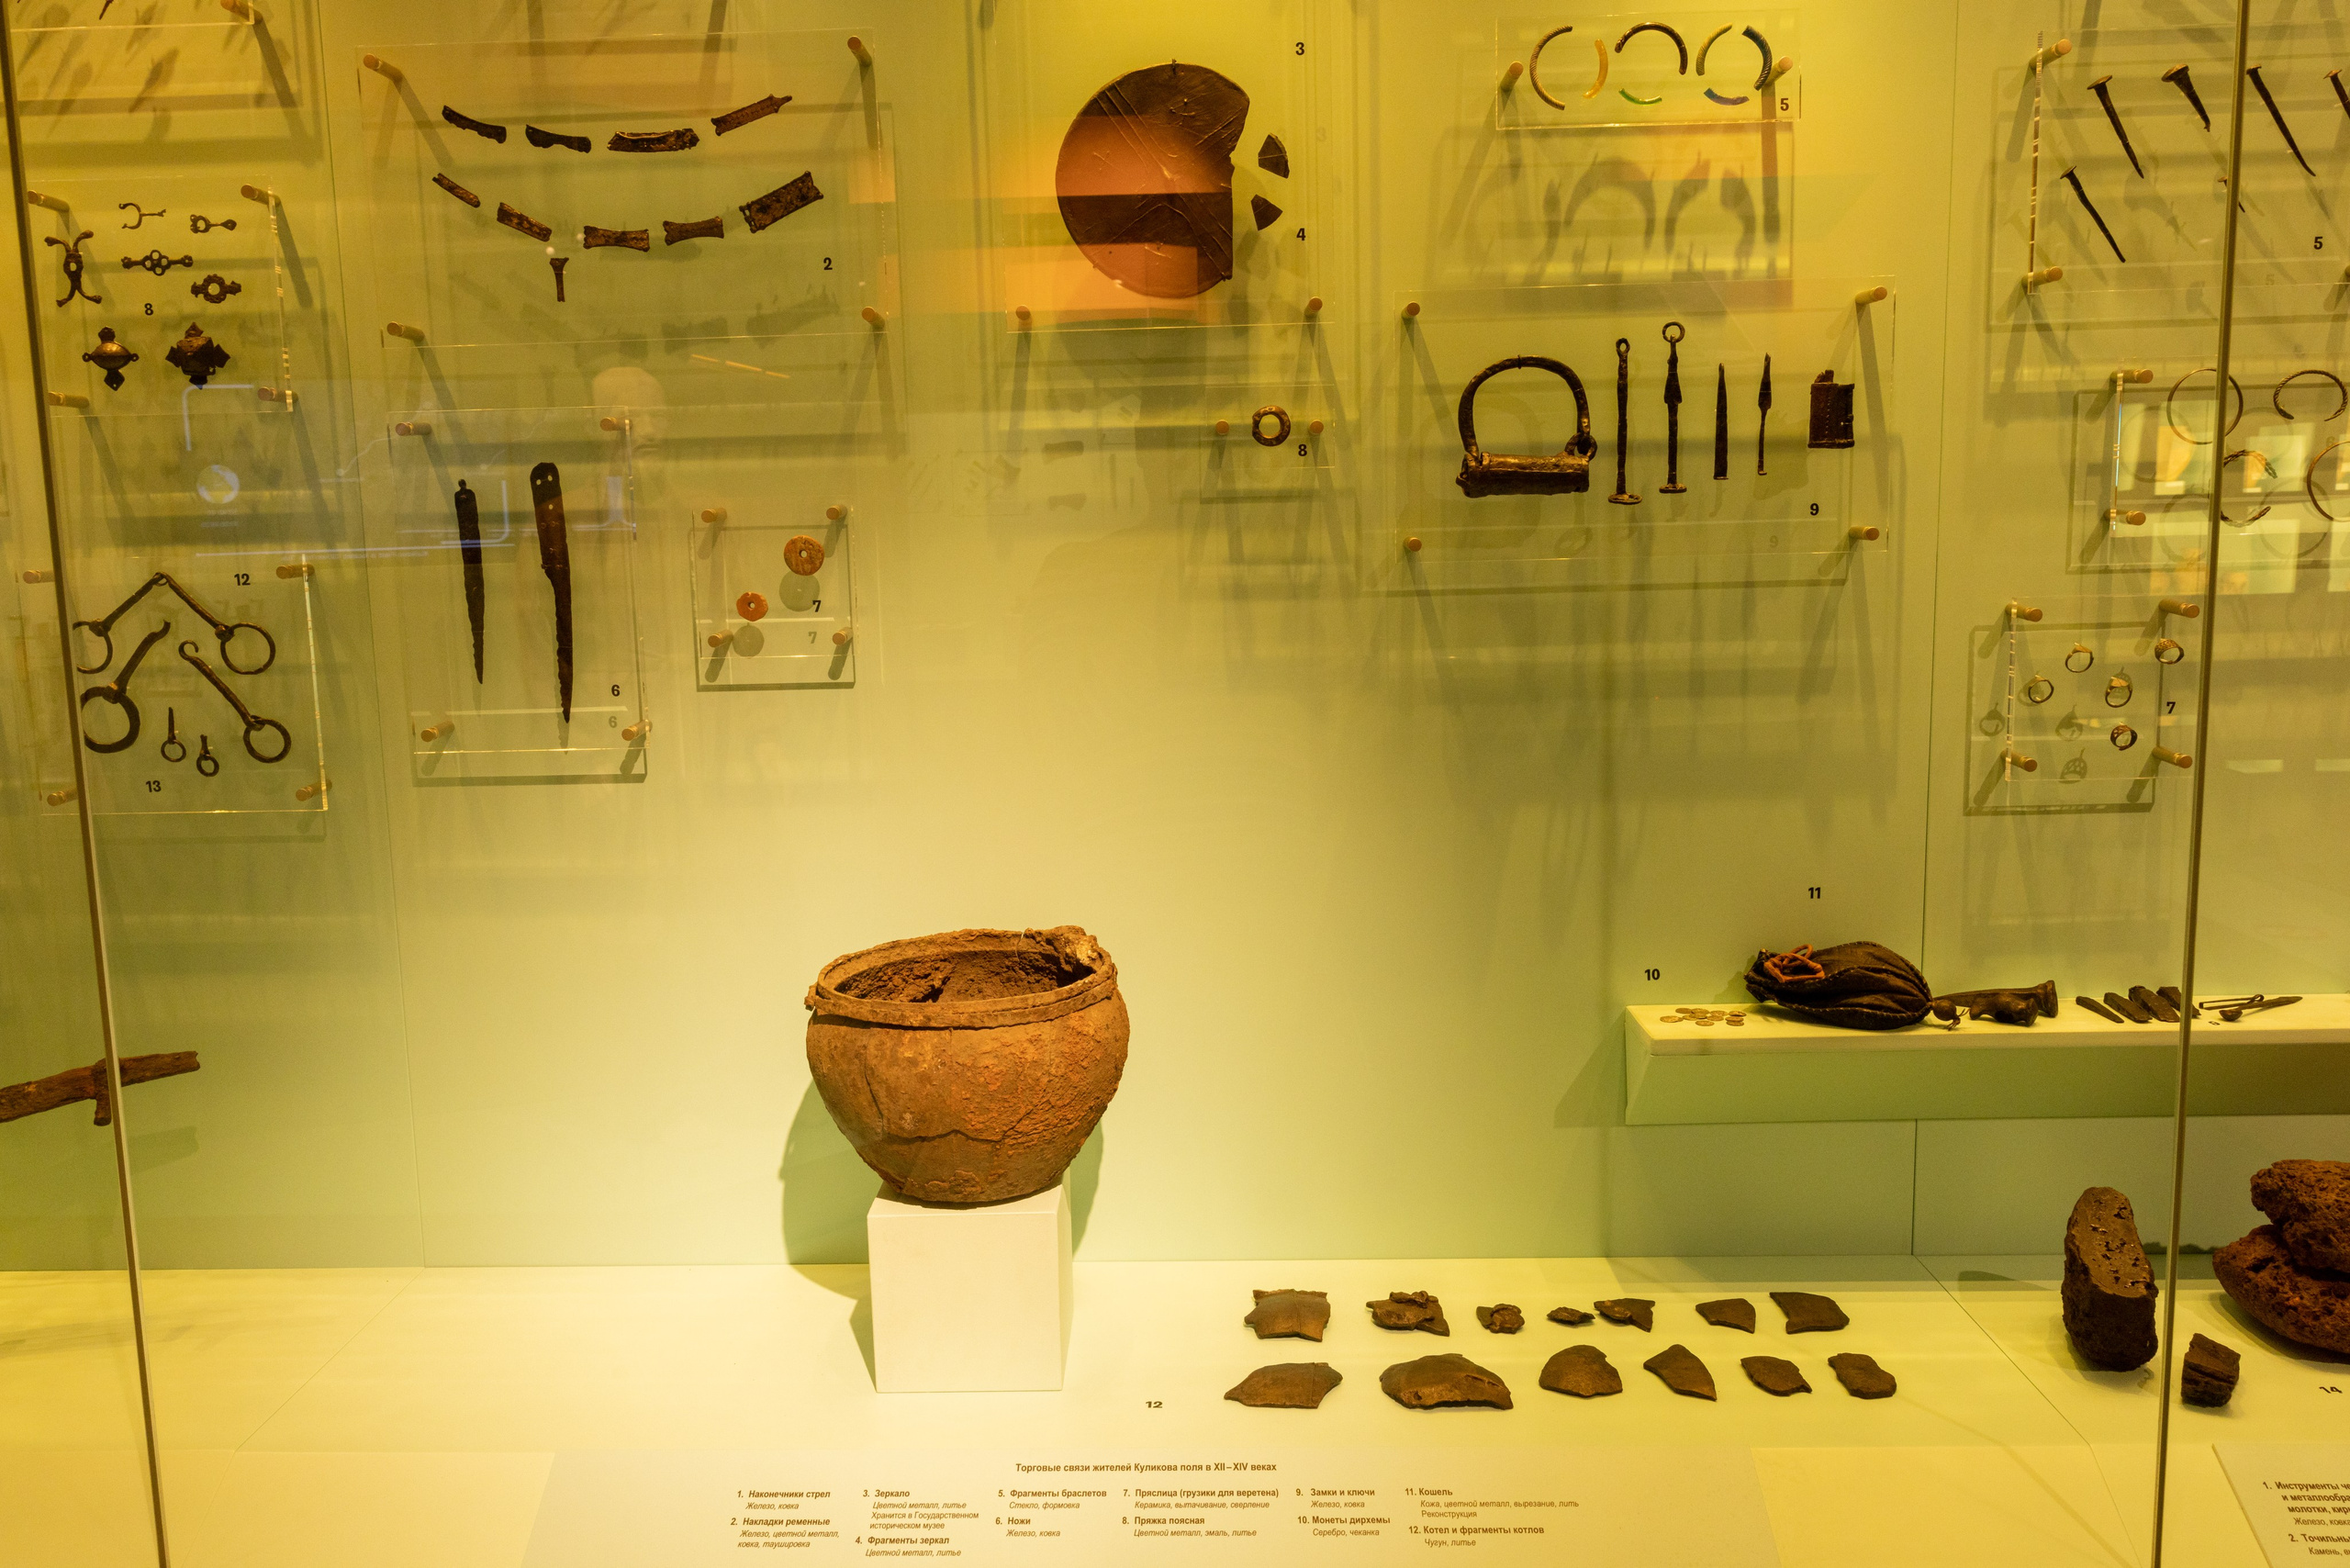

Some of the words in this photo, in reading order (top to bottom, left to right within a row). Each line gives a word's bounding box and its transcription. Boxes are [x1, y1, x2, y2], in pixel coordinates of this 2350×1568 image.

[1296, 42, 1304, 55] 3
[1780, 97, 1789, 111] 5
[1296, 228, 1305, 241] 4
[2314, 237, 2322, 250] 5
[823, 257, 833, 270] 2
[144, 303, 153, 315] 8
[1298, 444, 1307, 456] 8
[1810, 503, 1818, 516] 9
[234, 574, 251, 586] 12
[812, 600, 821, 612] 7
[611, 685, 620, 697] 6
[2166, 701, 2176, 714] 7
[146, 780, 162, 792] 13
[1808, 887, 1820, 899] 11
[1645, 969, 1660, 980] 10
[1016, 1463, 1061, 1473] Торговые
[1092, 1463, 1131, 1472] жителей
[1135, 1463, 1178, 1473] Куликова
[2275, 1482, 2340, 1491] Инструменты
[875, 1489, 910, 1498] Зеркало
[1010, 1490, 1059, 1498] Фрагменты
[1062, 1489, 1106, 1498] браслетов
[1136, 1489, 1177, 1498] Пряслица
[1180, 1489, 1216, 1498] (грузики
[1236, 1488, 1280, 1498] веретена)
[1042, 1502, 1080, 1510] формовка
[1444, 1500, 1477, 1508] цветной
[871, 1512, 906, 1520] Хранится
[914, 1511, 979, 1520] Государственном
[1421, 1510, 1477, 1519] Реконструкция
[743, 1518, 784, 1527] Накладки
[996, 1517, 1002, 1525] 6.
[1008, 1517, 1031, 1525] Ножи
[1135, 1517, 1166, 1526] Пряжка
[1298, 1516, 1309, 1524] 10.
[1313, 1516, 1347, 1524] Монеты
[773, 1530, 806, 1539] цветной
[1134, 1529, 1169, 1538] Цветной
[1409, 1526, 1421, 1534] 12.
[1424, 1526, 1449, 1534] Котел
[1460, 1526, 1511, 1536] фрагменты
[763, 1541, 811, 1550] таушировка
[856, 1536, 862, 1544] 4.
[867, 1536, 917, 1546] Фрагменты
[920, 1538, 949, 1546] зеркал
[866, 1549, 901, 1557] Цветной
